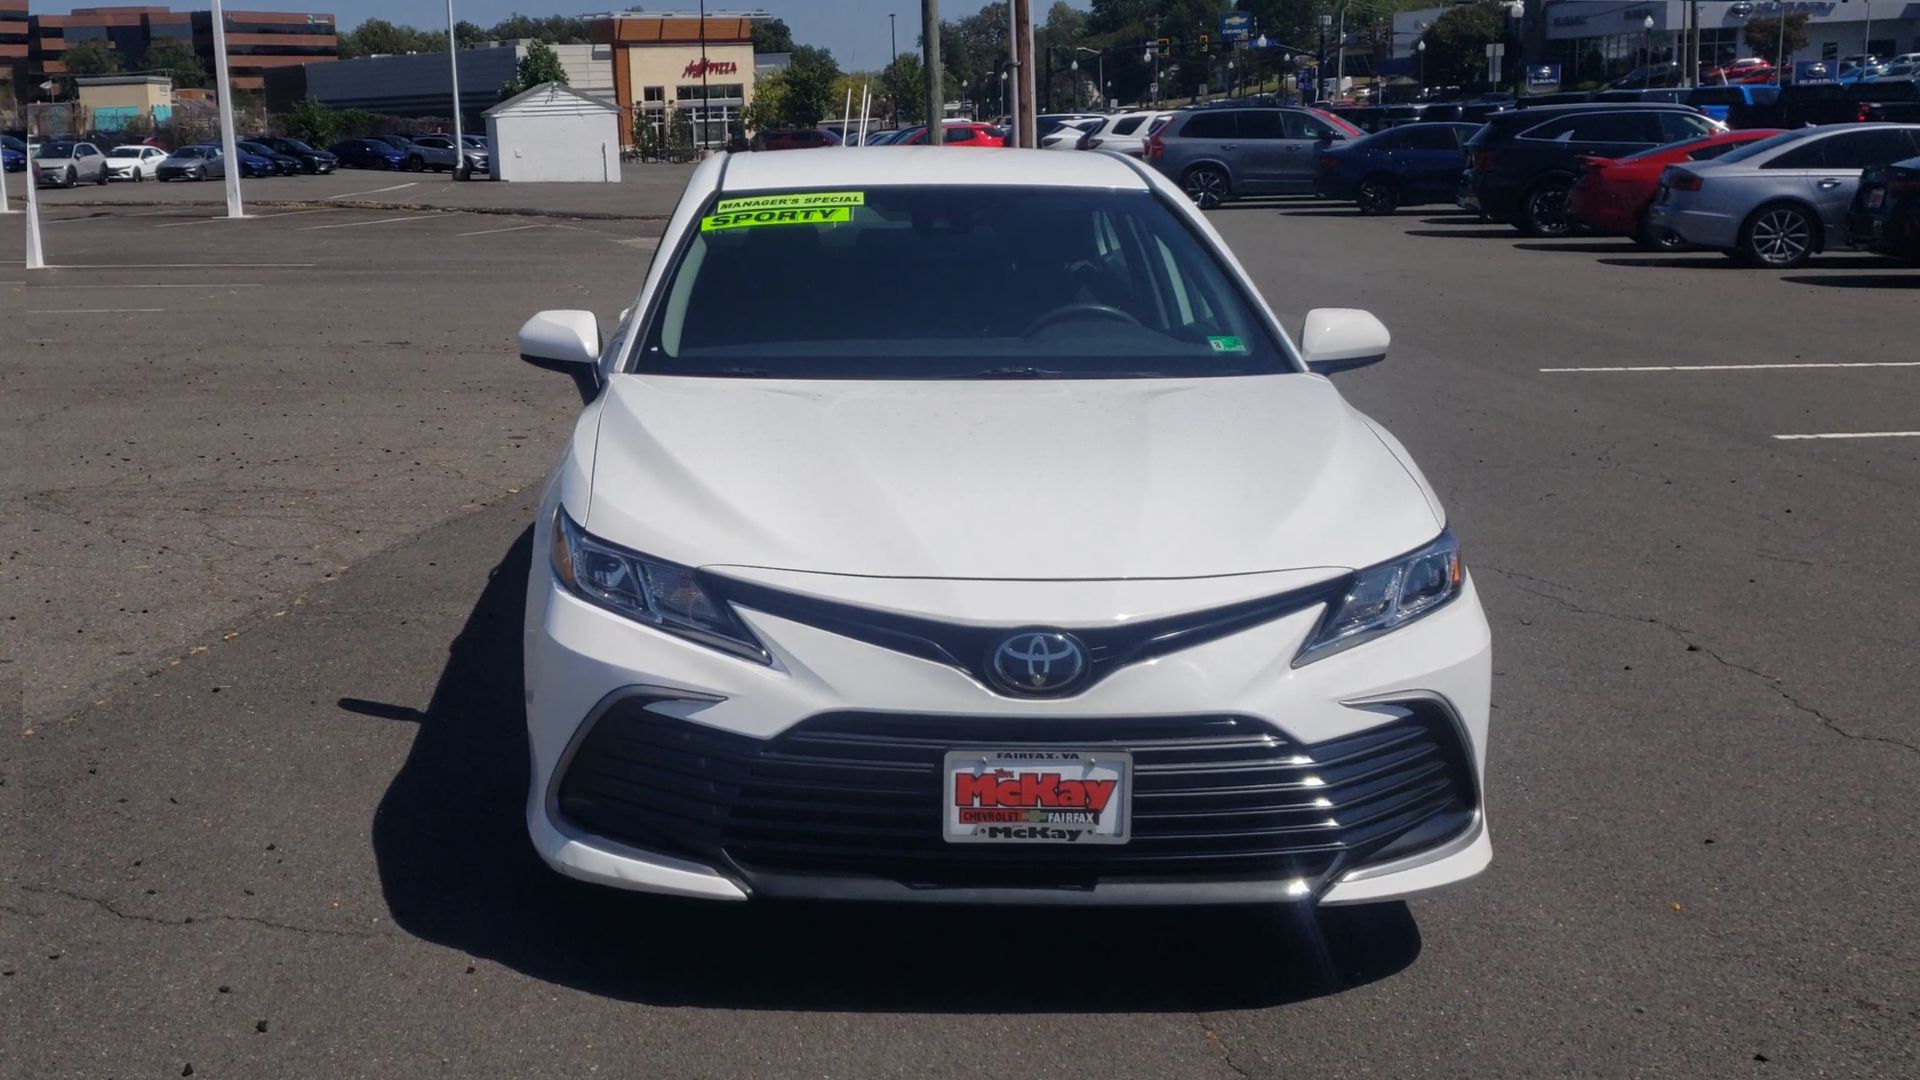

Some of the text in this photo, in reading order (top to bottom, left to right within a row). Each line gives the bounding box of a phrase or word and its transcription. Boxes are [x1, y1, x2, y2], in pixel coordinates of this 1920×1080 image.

[720, 195, 861, 209] MANAGER'S SPECIAL
[711, 209, 836, 225] SPORTY
[955, 773, 1118, 812] McKay
[963, 810, 1094, 824] CHEVROLET FAIRFAX
[989, 827, 1082, 841] McKay
